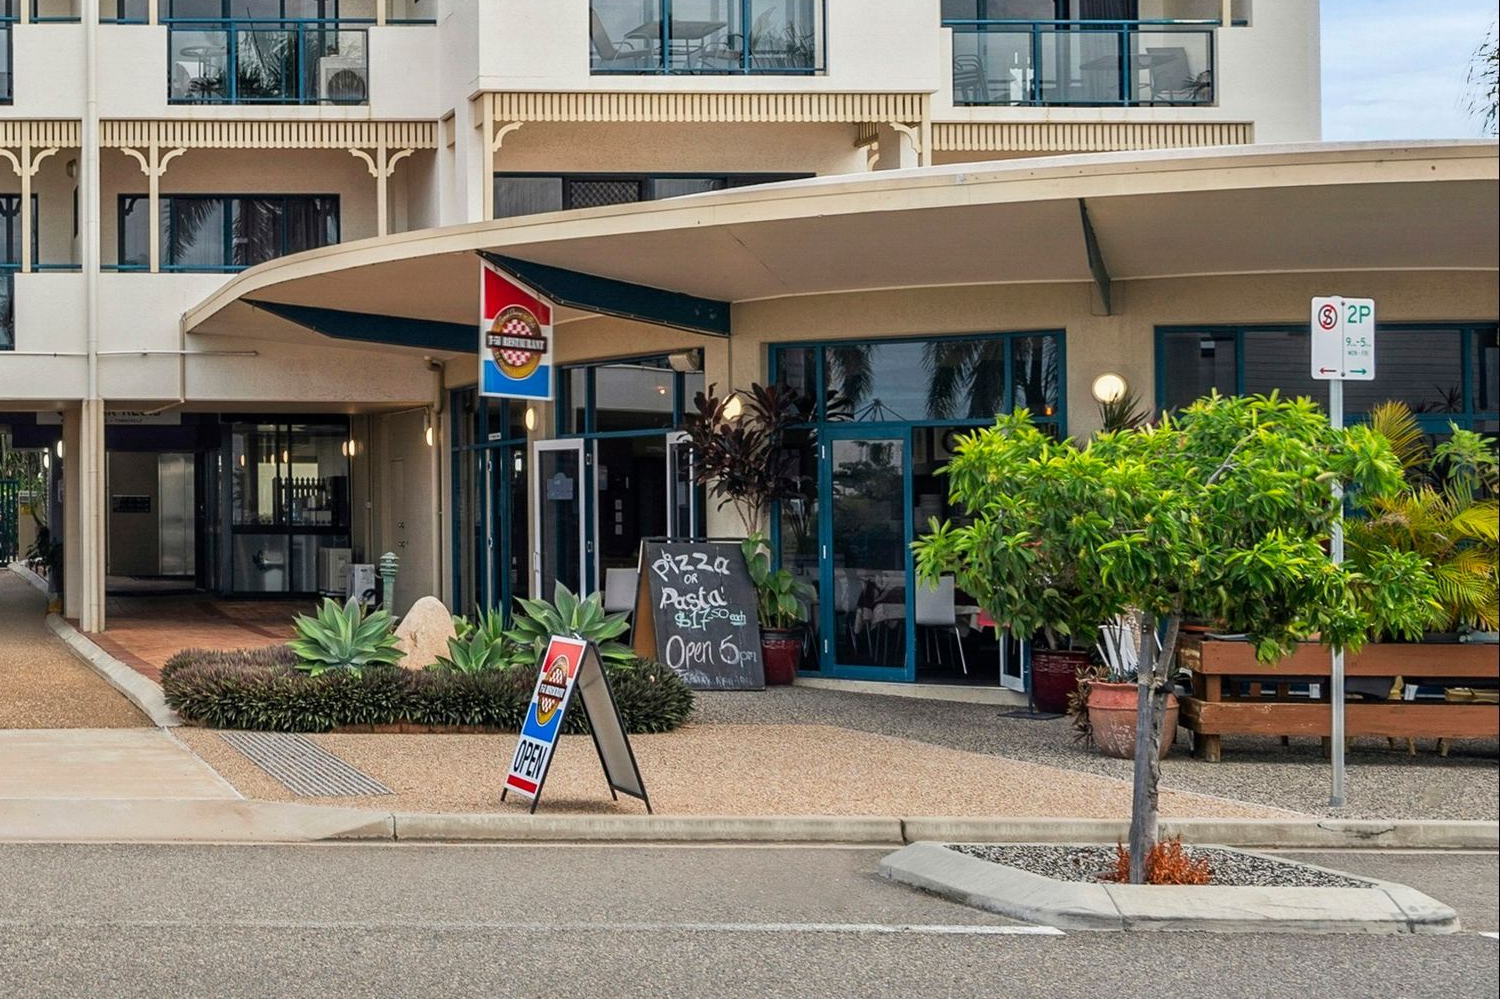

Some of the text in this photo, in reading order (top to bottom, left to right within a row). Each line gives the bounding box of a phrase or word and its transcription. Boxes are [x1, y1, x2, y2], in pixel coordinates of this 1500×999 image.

[1347, 305, 1371, 324] 2P
[683, 573, 699, 585] OR
[665, 635, 715, 669] Open
[514, 739, 548, 779] OPEN
